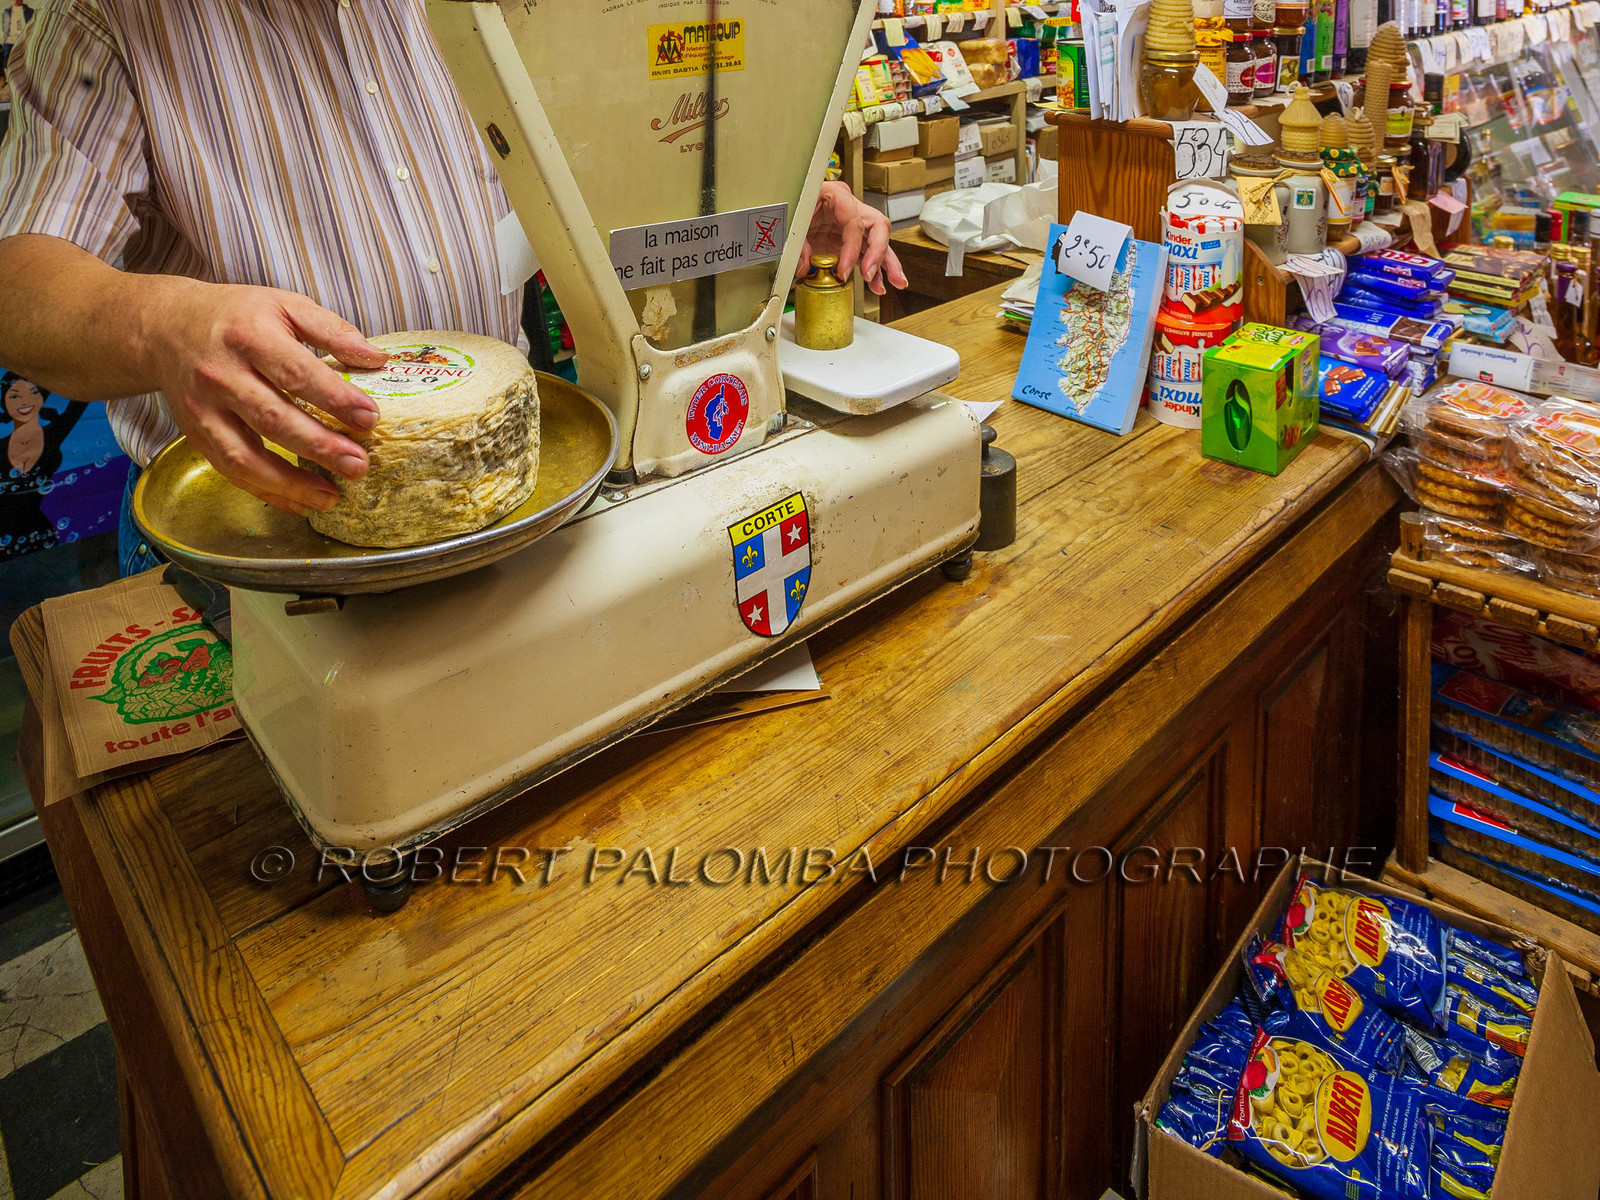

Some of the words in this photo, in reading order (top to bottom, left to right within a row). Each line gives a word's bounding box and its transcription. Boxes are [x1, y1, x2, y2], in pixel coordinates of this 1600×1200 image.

[601, 4, 624, 14] CADRAN
[680, 141, 707, 153] LYO
[645, 228, 657, 248] la
[665, 223, 719, 245] maison
[614, 264, 634, 280] ne
[640, 256, 665, 276] fait
[672, 252, 698, 277] pas
[704, 240, 744, 264] crédit
[1164, 241, 1198, 260] maxi
[1460, 348, 1484, 360] chocolat
[688, 385, 708, 420] INTER
[708, 374, 748, 406] CORTENAIS
[1022, 384, 1052, 400] Corse
[1159, 385, 1202, 404] maxi
[690, 419, 744, 453] MINI-BASKET
[742, 501, 795, 536] CORTE
[70, 624, 152, 690] FRUITS
[172, 606, 204, 625] SA
[105, 722, 192, 754] toute
[1325, 1074, 1365, 1151] ALIBERT
